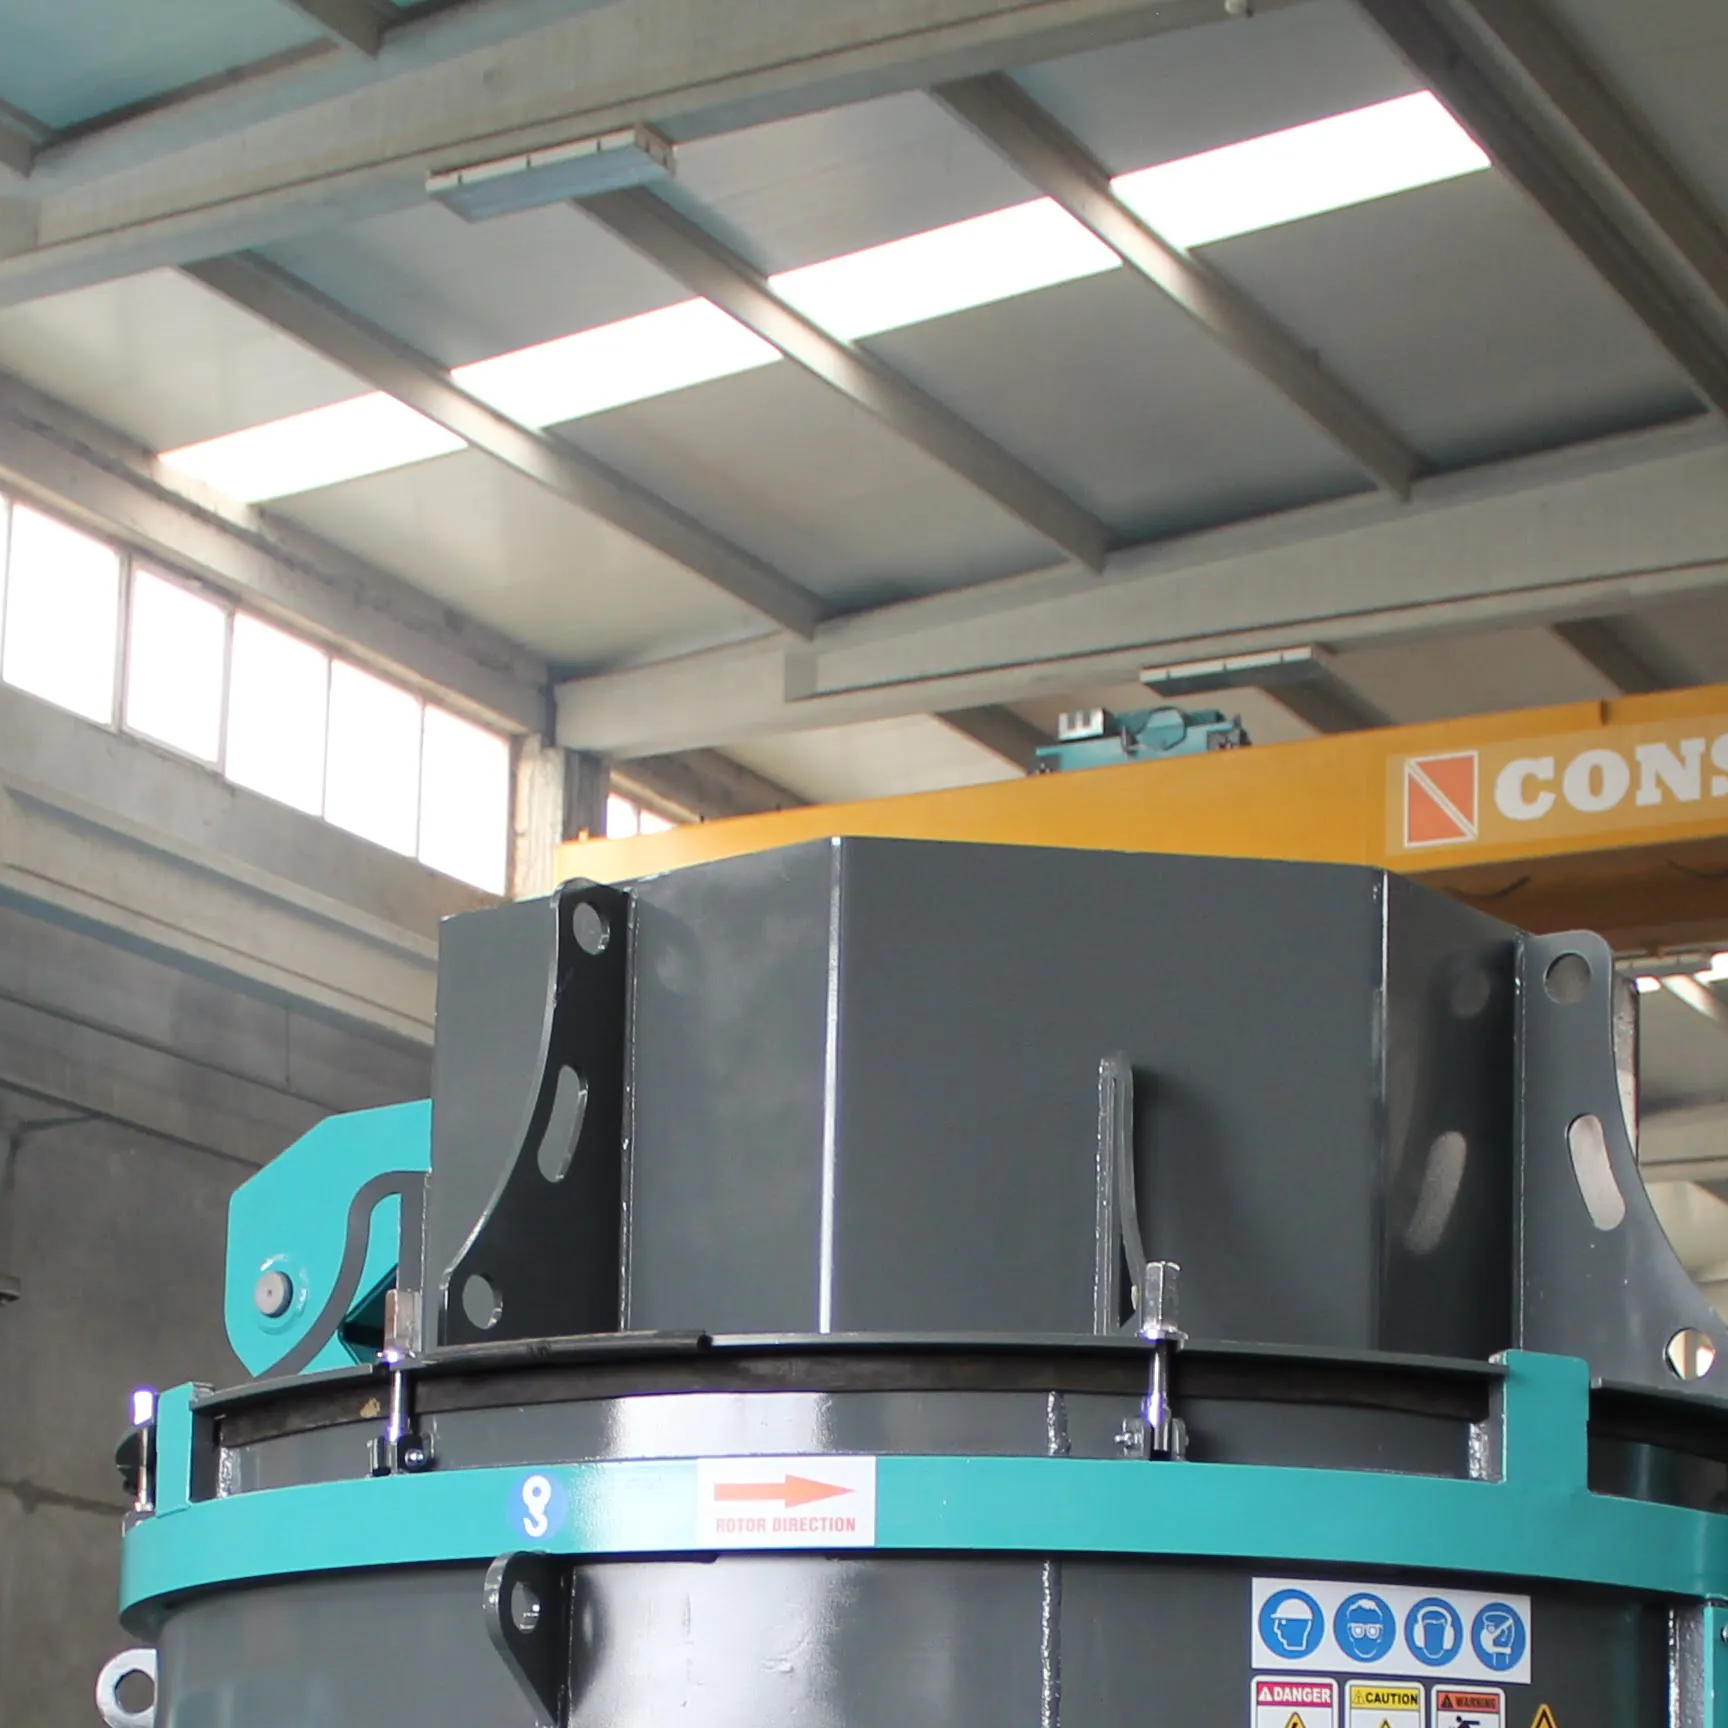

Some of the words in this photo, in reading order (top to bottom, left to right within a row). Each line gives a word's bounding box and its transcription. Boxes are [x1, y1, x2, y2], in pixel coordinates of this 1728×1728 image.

[715, 1517, 767, 1533] ROTOR
[772, 1516, 856, 1533] DIRECTION
[1273, 1686, 1331, 1703] DANGER
[1365, 1691, 1419, 1705] CAUTION
[1455, 1696, 1496, 1709] WARNING
